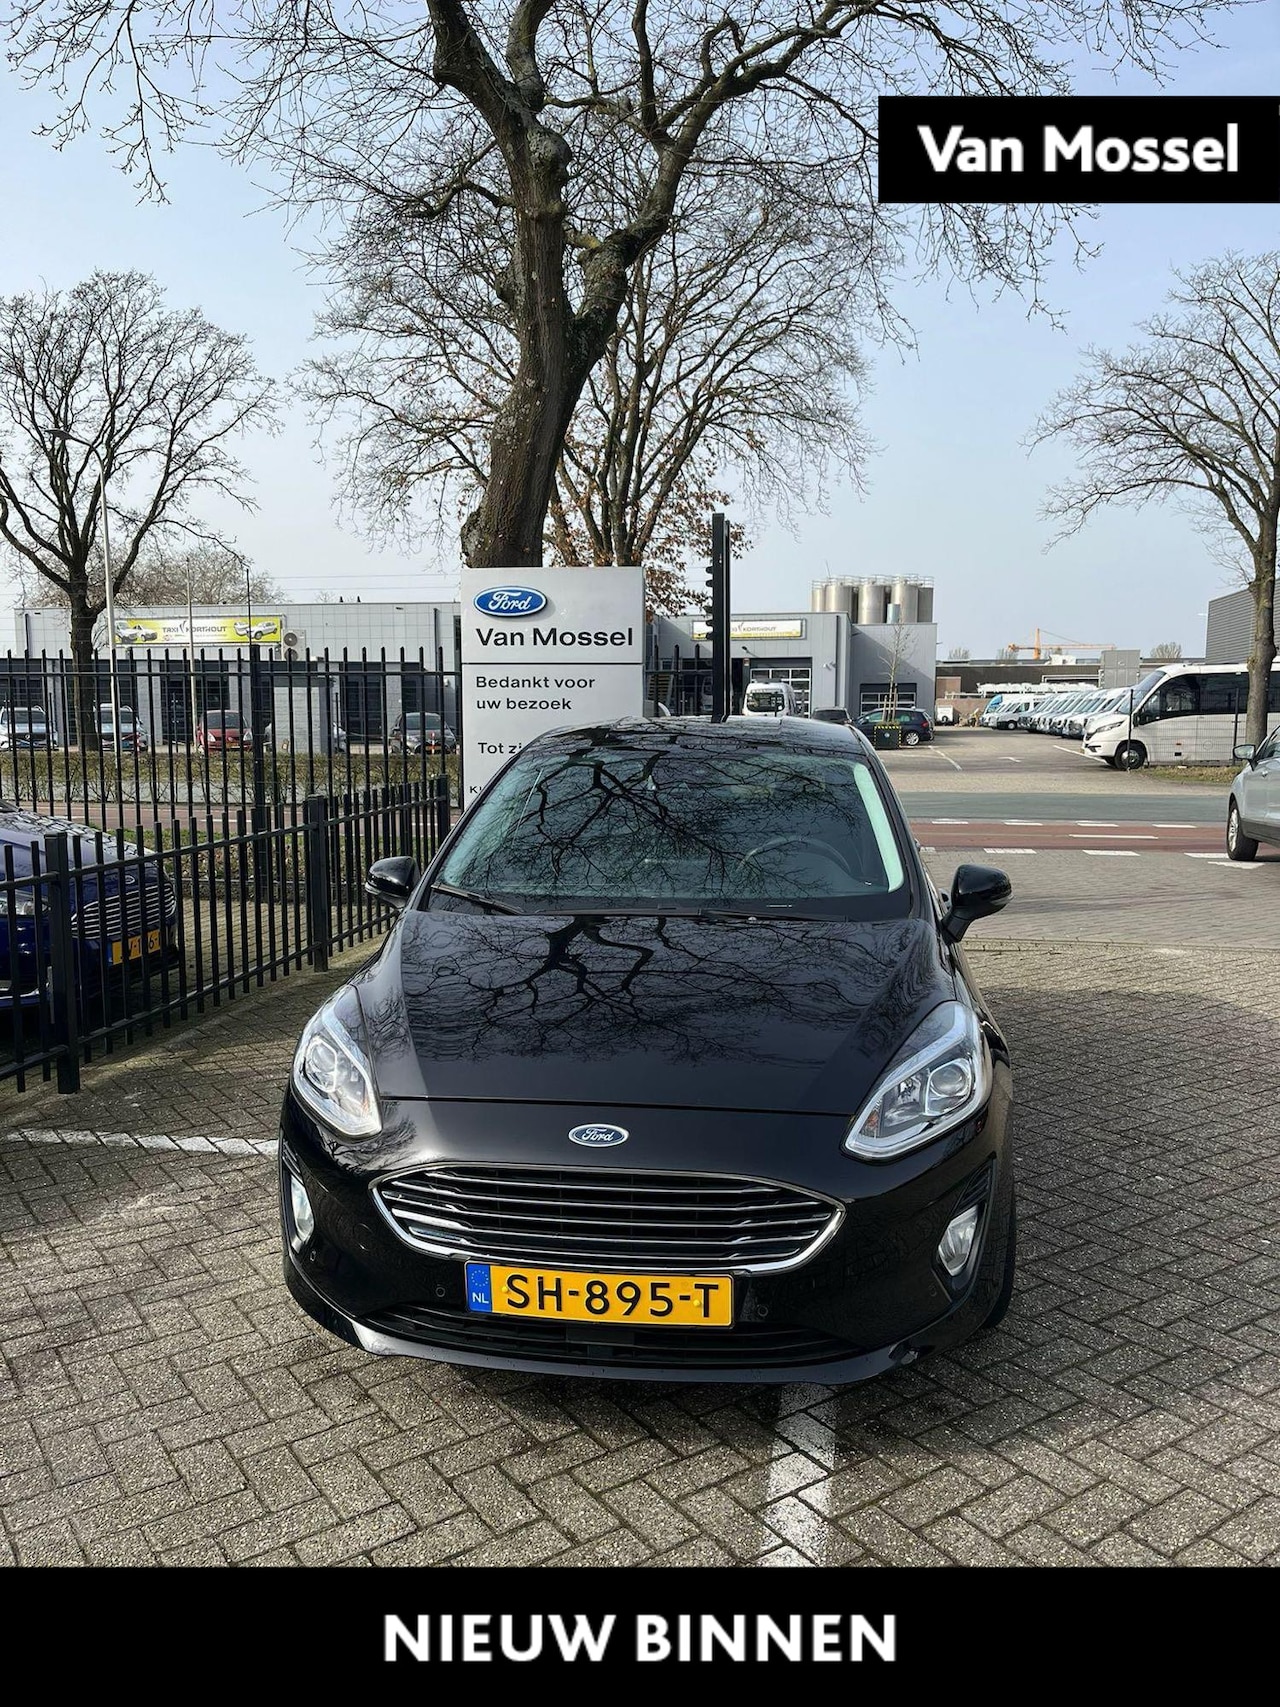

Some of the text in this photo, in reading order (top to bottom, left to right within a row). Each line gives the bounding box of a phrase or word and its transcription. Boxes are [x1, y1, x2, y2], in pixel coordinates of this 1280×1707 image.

[476, 627, 633, 647] Van Mossel
[476, 676, 596, 689] Bedankt voor
[476, 697, 572, 710] uw bezoek
[477, 742, 504, 754] Tot
[472, 1292, 489, 1305] NL
[505, 1273, 720, 1319] SH-895-T
